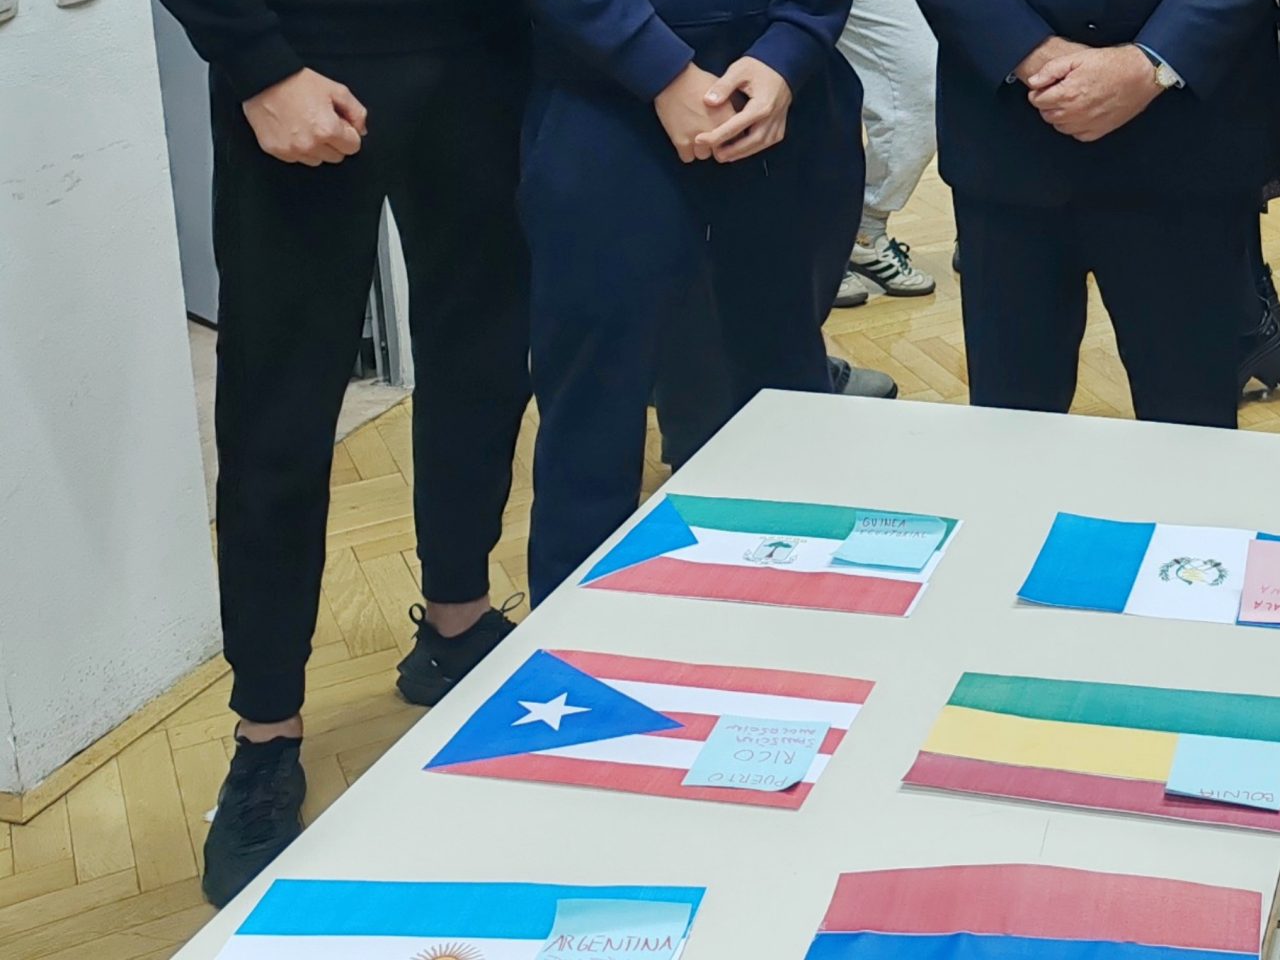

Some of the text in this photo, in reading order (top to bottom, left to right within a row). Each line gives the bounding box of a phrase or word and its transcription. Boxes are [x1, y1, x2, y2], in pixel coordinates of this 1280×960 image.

[862, 516, 906, 528] GUINEA
[733, 749, 796, 765] RICO
[707, 772, 788, 788] PUERTO
[543, 934, 673, 953] ARGENTINA
